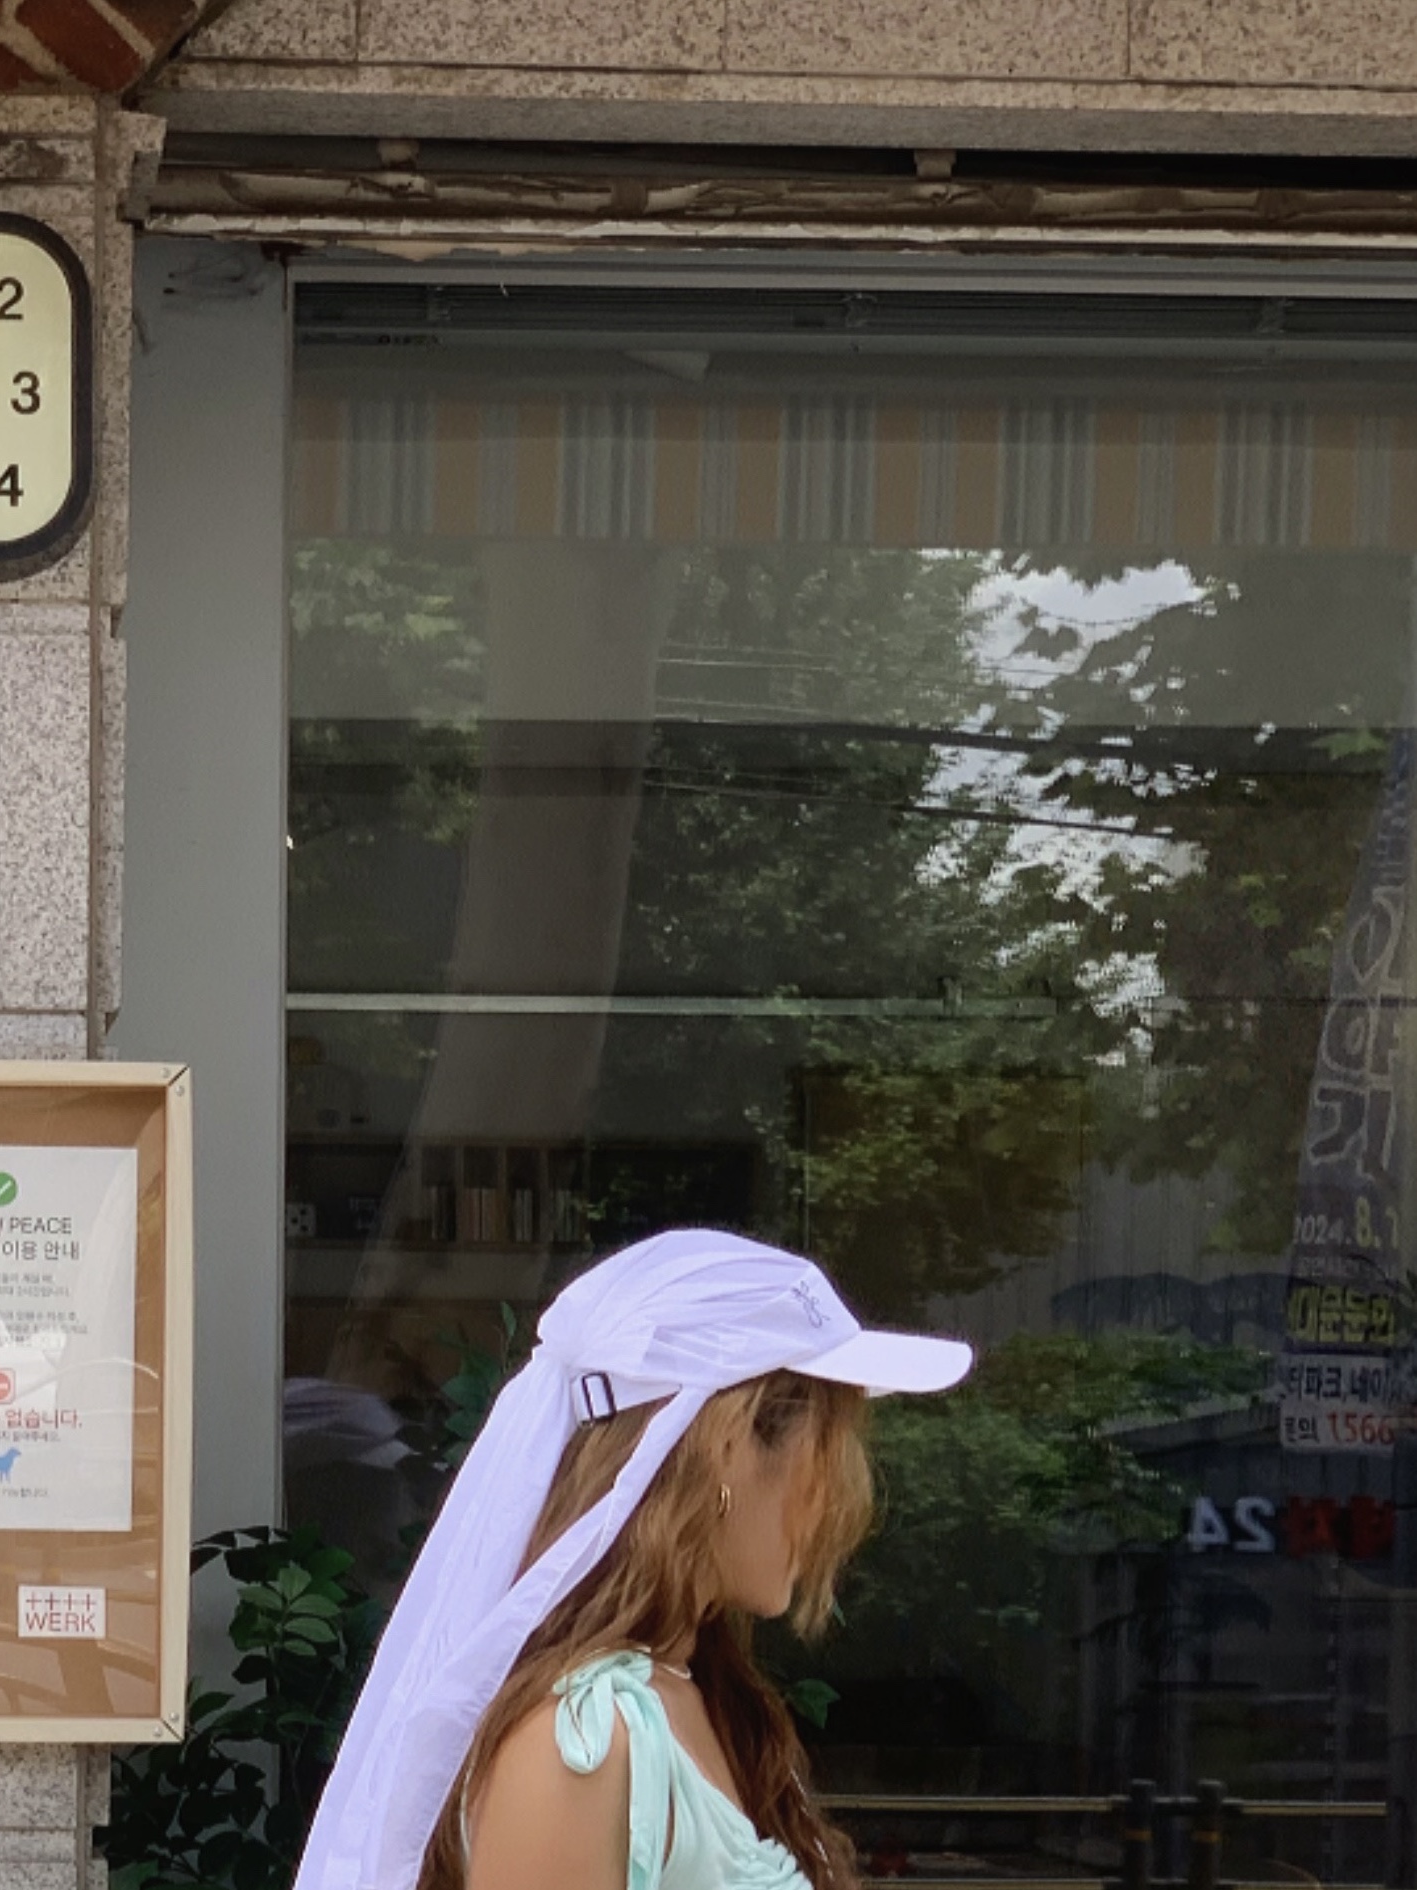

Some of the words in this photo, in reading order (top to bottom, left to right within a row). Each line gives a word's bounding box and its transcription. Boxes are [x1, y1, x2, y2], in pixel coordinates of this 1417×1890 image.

[10, 371, 41, 415] 3
[9, 1216, 73, 1235] PEACE
[1, 1240, 38, 1261] 이용
[44, 1240, 80, 1261] 안내
[5, 1408, 83, 1430] 없습니다.
[25, 1612, 96, 1632] WERK
